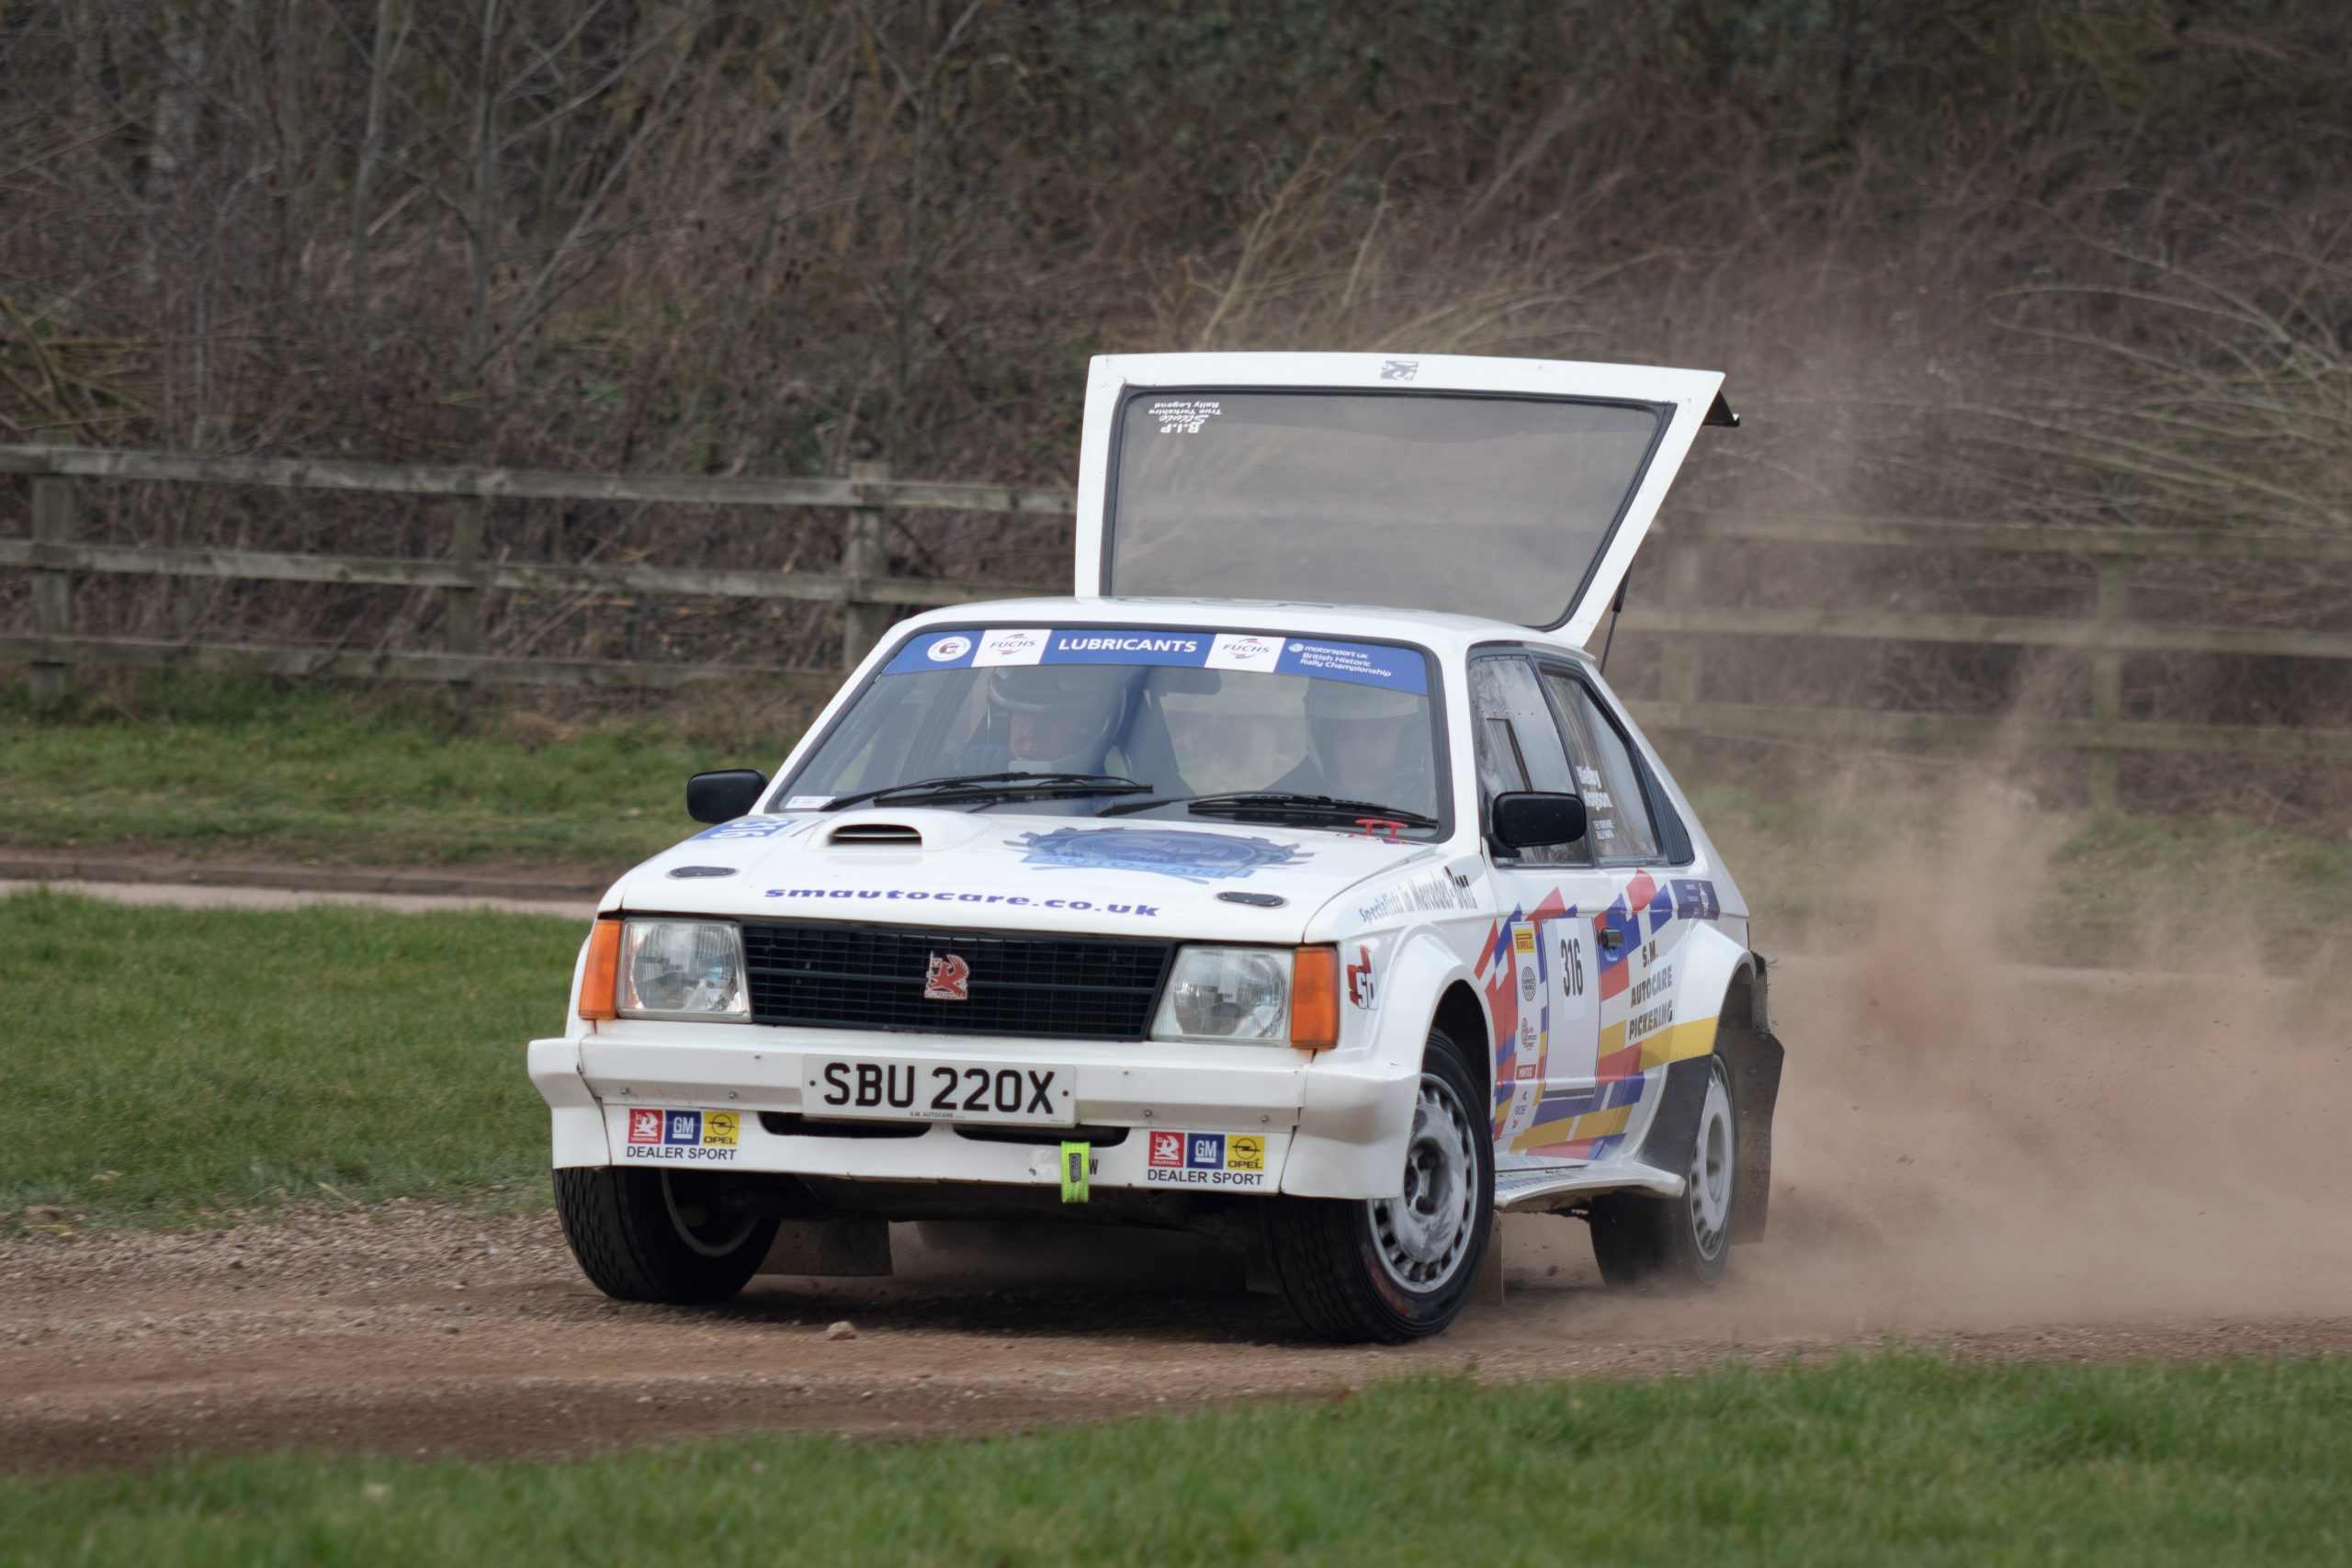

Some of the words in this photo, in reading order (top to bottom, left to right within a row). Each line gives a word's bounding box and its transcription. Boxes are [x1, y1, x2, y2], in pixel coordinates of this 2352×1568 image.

[1154, 400, 1191, 409] Legend
[1193, 400, 1219, 409] Rally
[989, 639, 1036, 649] FUCHS
[1058, 637, 1197, 653] LUBRICANTS
[1223, 643, 1271, 654] FUCHS
[1305, 646, 1355, 658] motorsport
[1300, 659, 1323, 668] Rally
[1325, 660, 1391, 677] Championship
[1302, 652, 1332, 661] British
[1335, 657, 1371, 668] Historic
[711, 820, 788, 839] 316
[764, 887, 1161, 917] smautocare.co.uk
[1515, 933, 1534, 951] PIRELLI
[1642, 940, 1658, 968] S.M.
[1560, 938, 1583, 997] 316
[1630, 964, 1672, 1009] AUTOCARE
[1629, 999, 1673, 1040] PICKERING
[823, 1062, 915, 1108] SBU
[931, 1066, 1055, 1114] 220X
[673, 1116, 695, 1134] GM
[703, 1136, 736, 1145] OPEL
[1194, 1139, 1218, 1158] GM
[627, 1145, 684, 1158] DEALER
[687, 1147, 737, 1160] SPORT
[1227, 1159, 1262, 1169] OPEL
[1148, 1168, 1208, 1183] DEALER
[1212, 1172, 1263, 1185] SPORT
